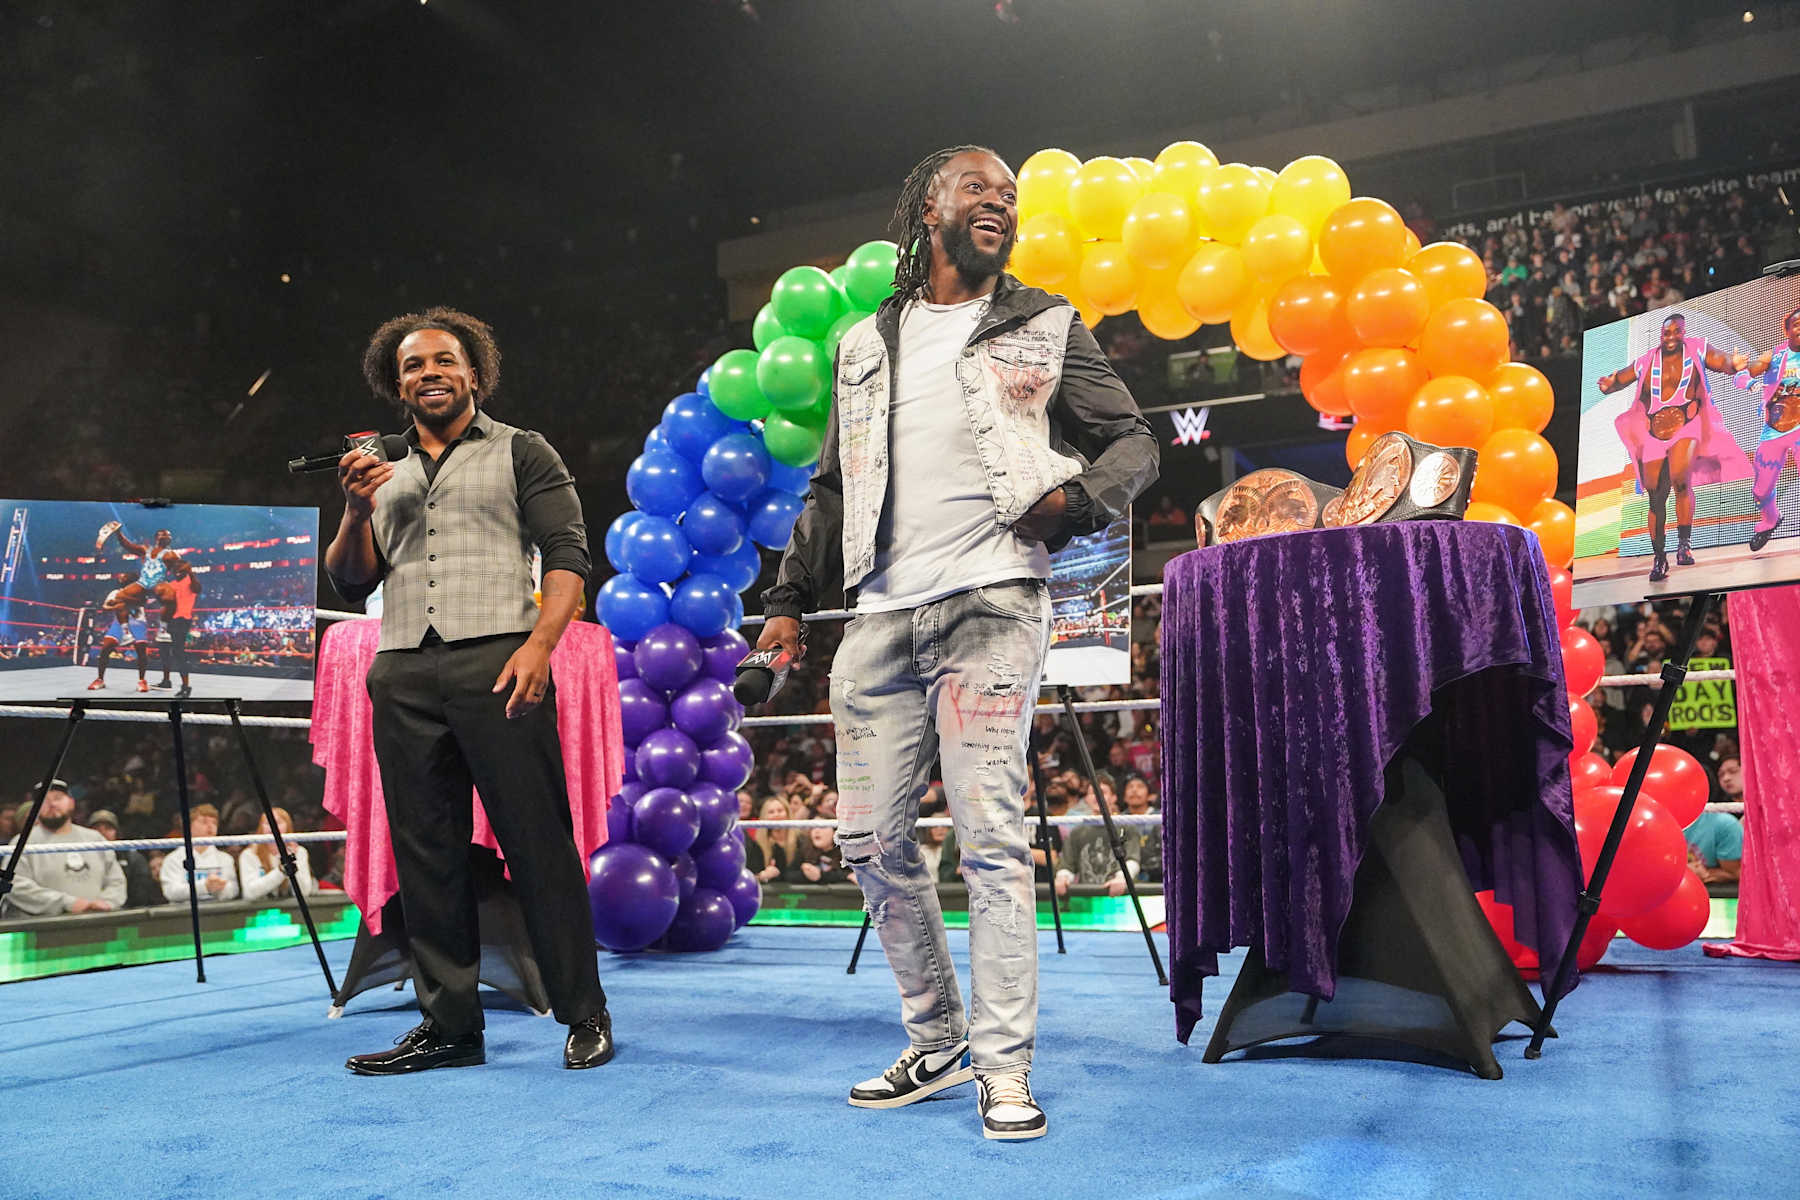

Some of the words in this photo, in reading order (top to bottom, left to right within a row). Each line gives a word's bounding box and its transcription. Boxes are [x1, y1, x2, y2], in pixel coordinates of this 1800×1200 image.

[1486, 211, 1524, 233] and
[1655, 178, 1740, 204] favorite
[1673, 681, 1727, 704] DAY
